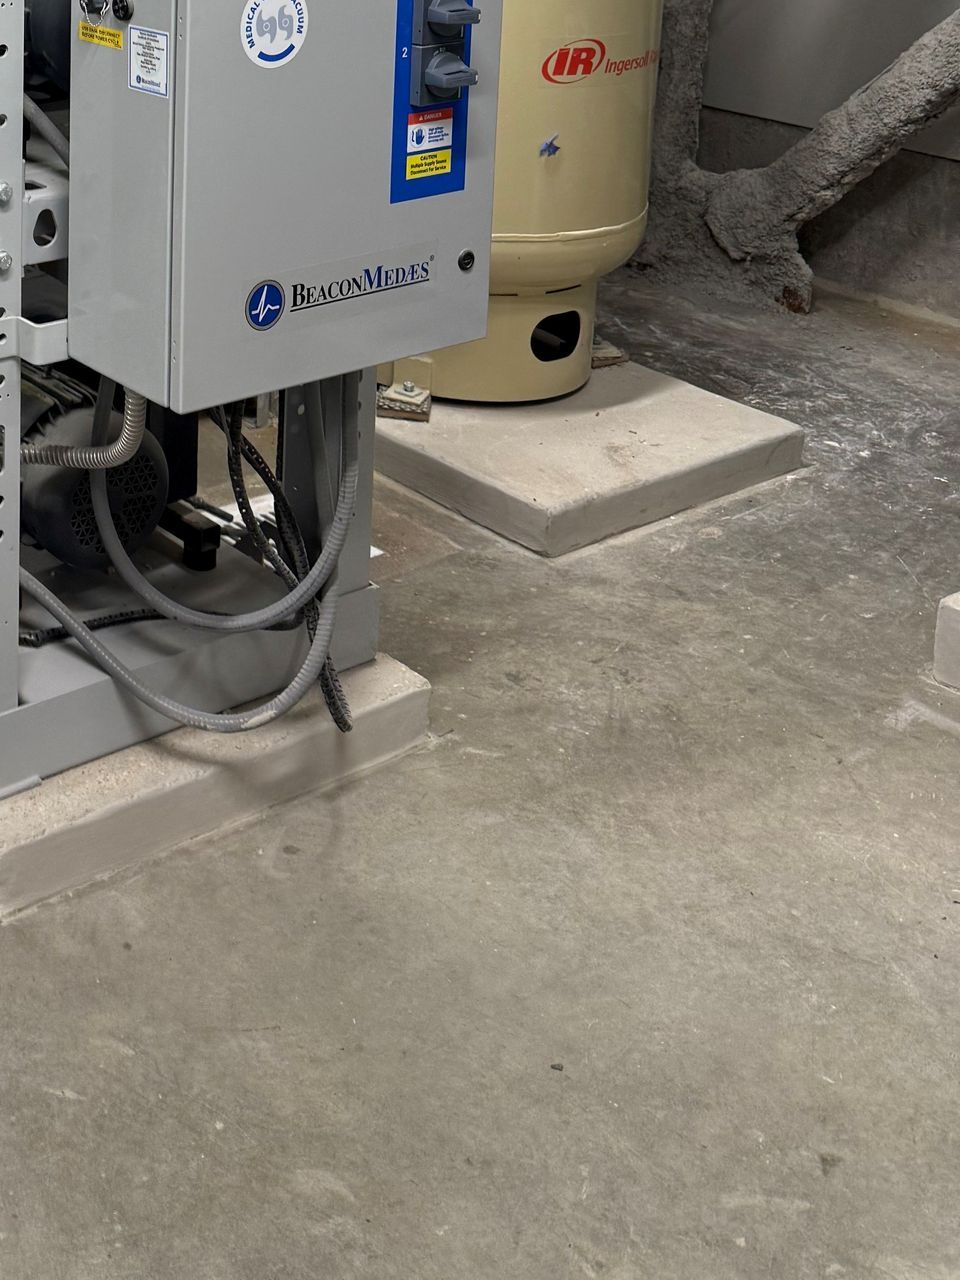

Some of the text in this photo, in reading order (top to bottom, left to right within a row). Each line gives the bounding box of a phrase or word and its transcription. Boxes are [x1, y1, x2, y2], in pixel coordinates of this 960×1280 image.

[245, 1, 260, 49] MEDICAL
[402, 47, 408, 58] 2
[552, 47, 597, 76] IR
[604, 50, 650, 76] Ingersoll
